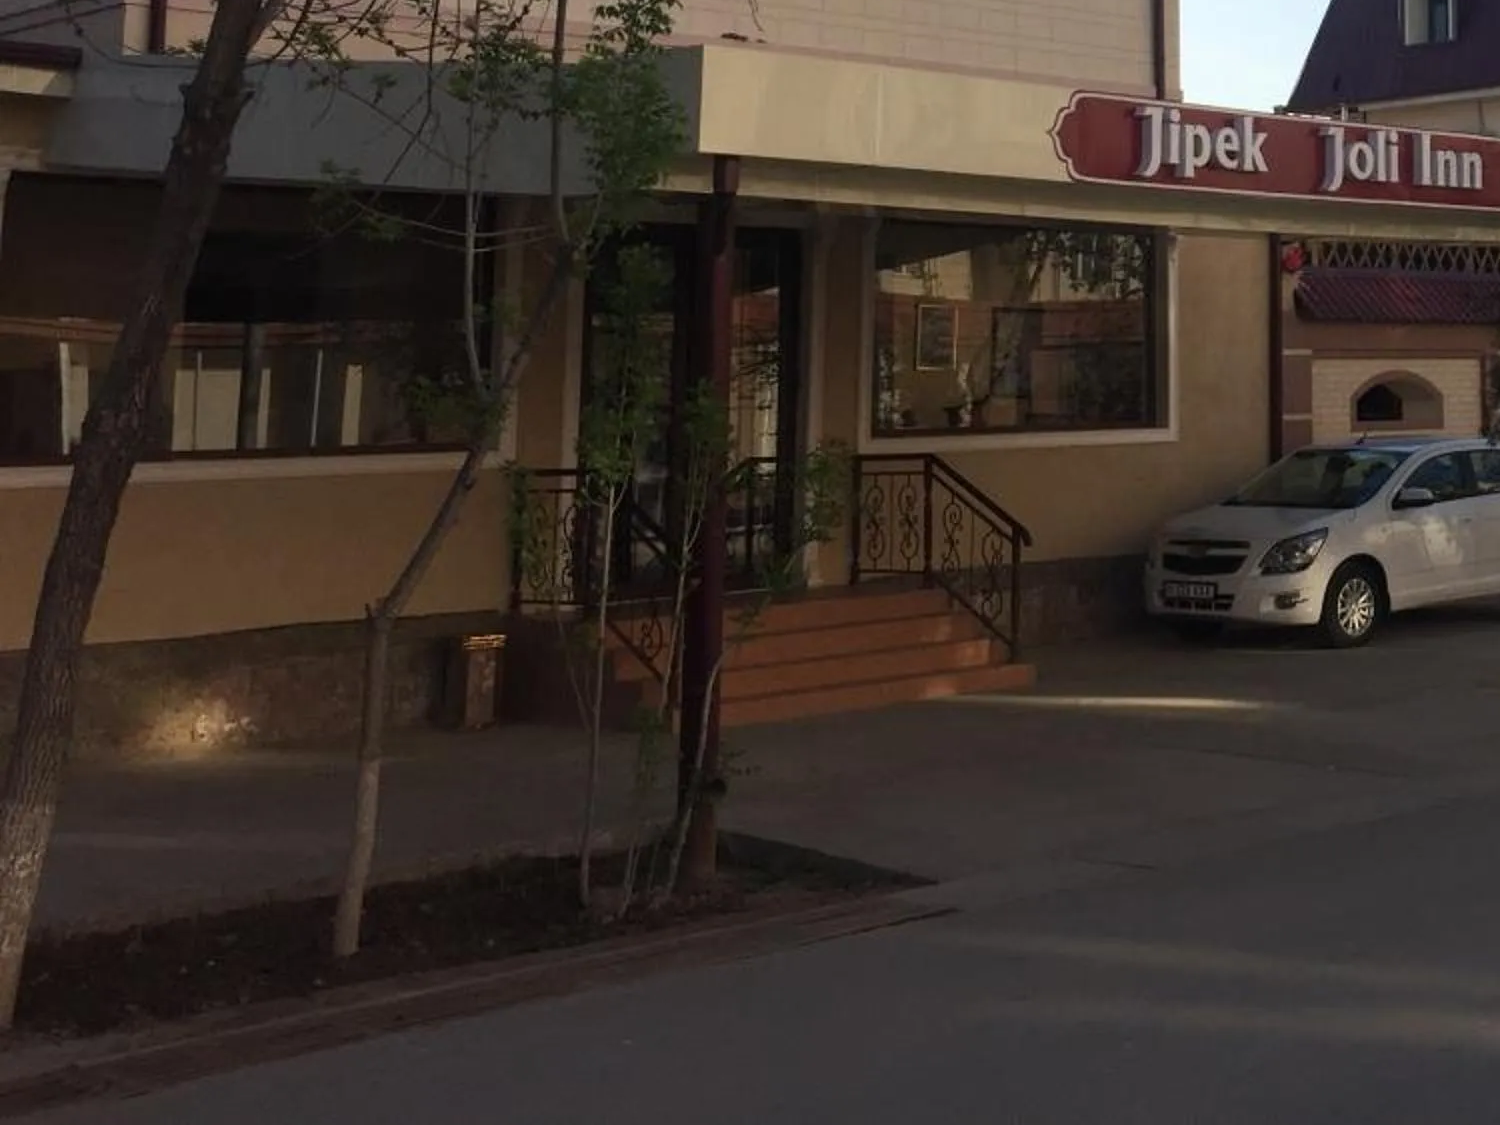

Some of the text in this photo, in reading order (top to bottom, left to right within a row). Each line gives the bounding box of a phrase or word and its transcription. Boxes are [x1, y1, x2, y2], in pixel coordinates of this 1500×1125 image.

[1135, 105, 1483, 192] Jipek Joli Inn
